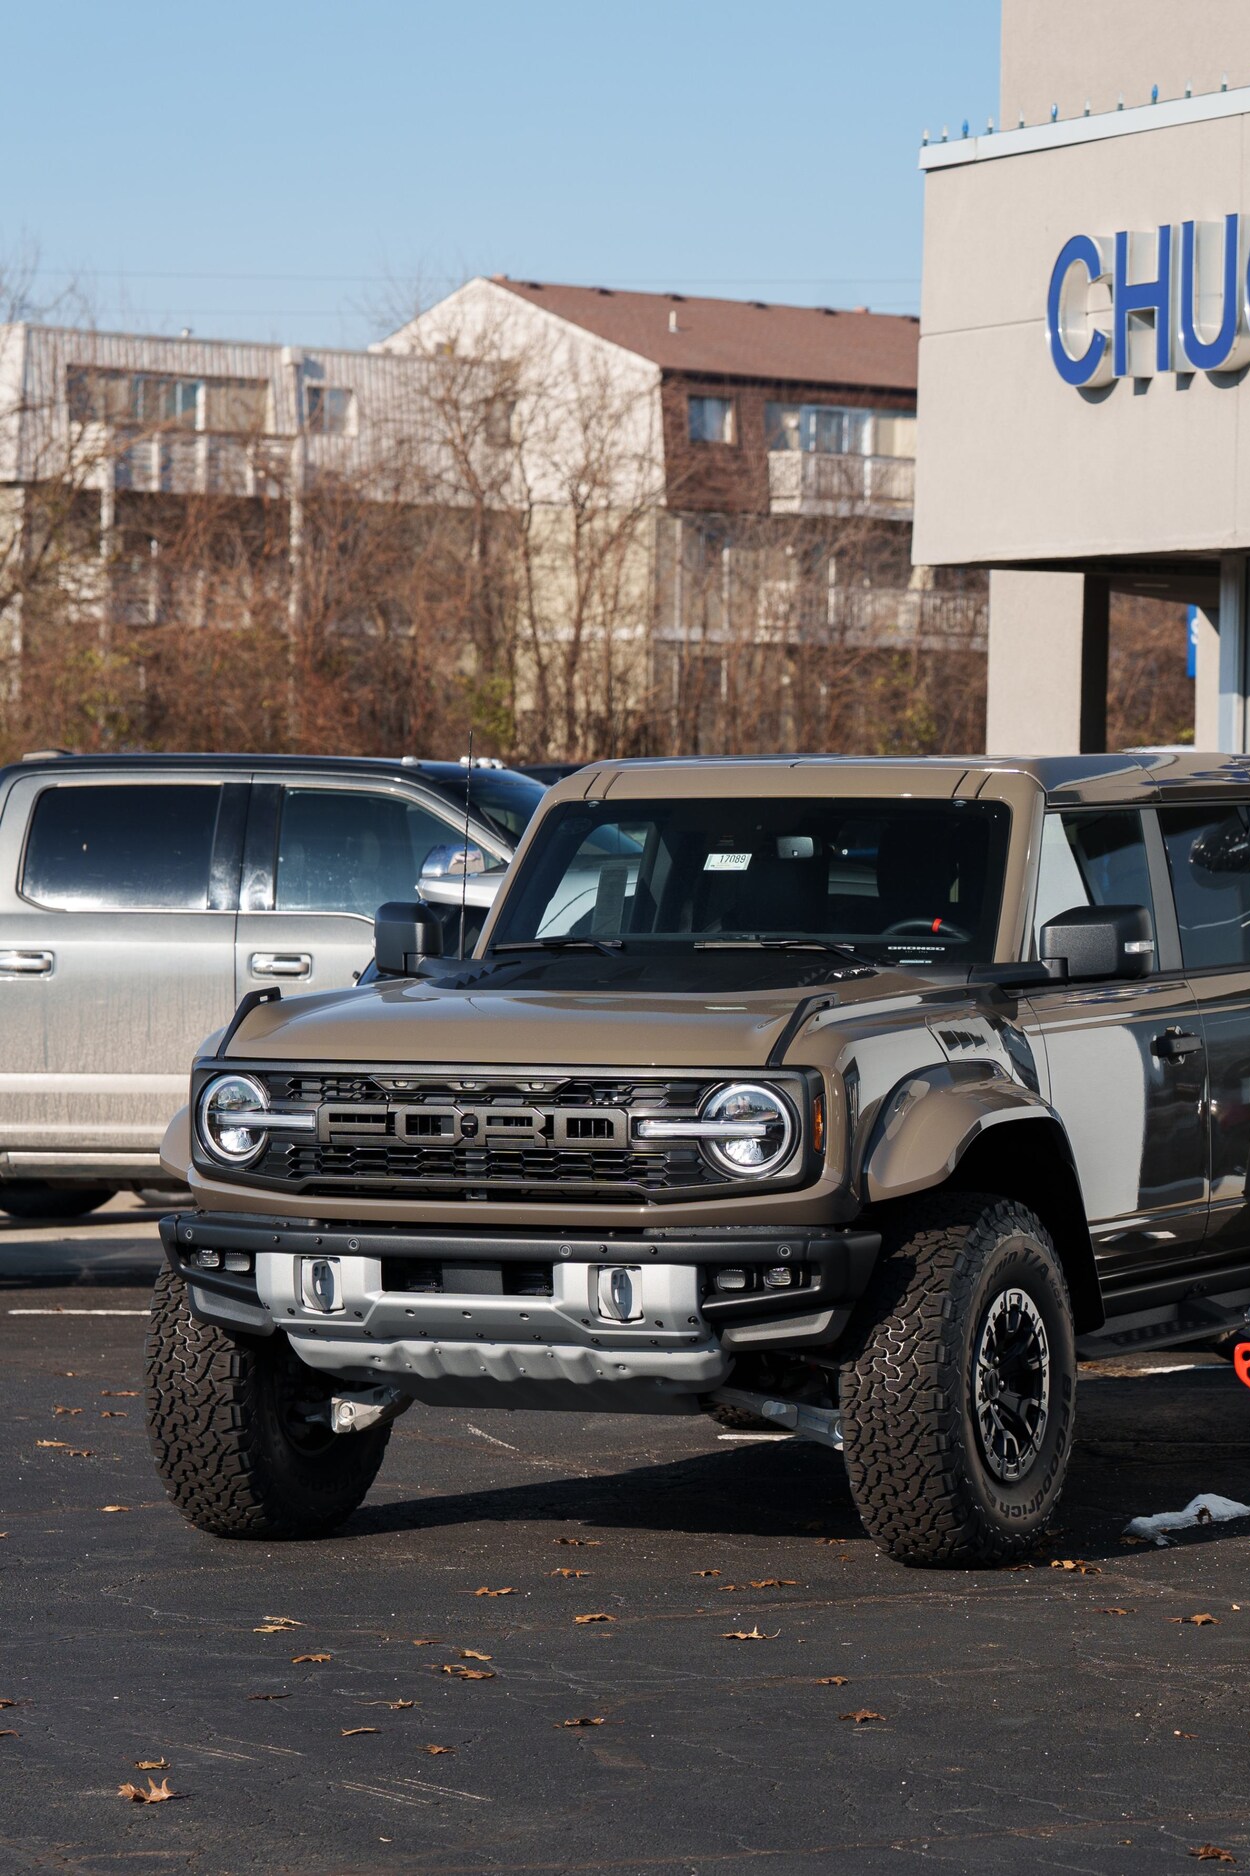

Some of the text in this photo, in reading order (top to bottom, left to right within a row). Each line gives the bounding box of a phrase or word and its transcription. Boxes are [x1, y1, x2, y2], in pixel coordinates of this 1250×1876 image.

[719, 854, 747, 864] 17089
[317, 1102, 629, 1148] FORD
[1000, 1373, 1072, 1521] BFGoodrich
